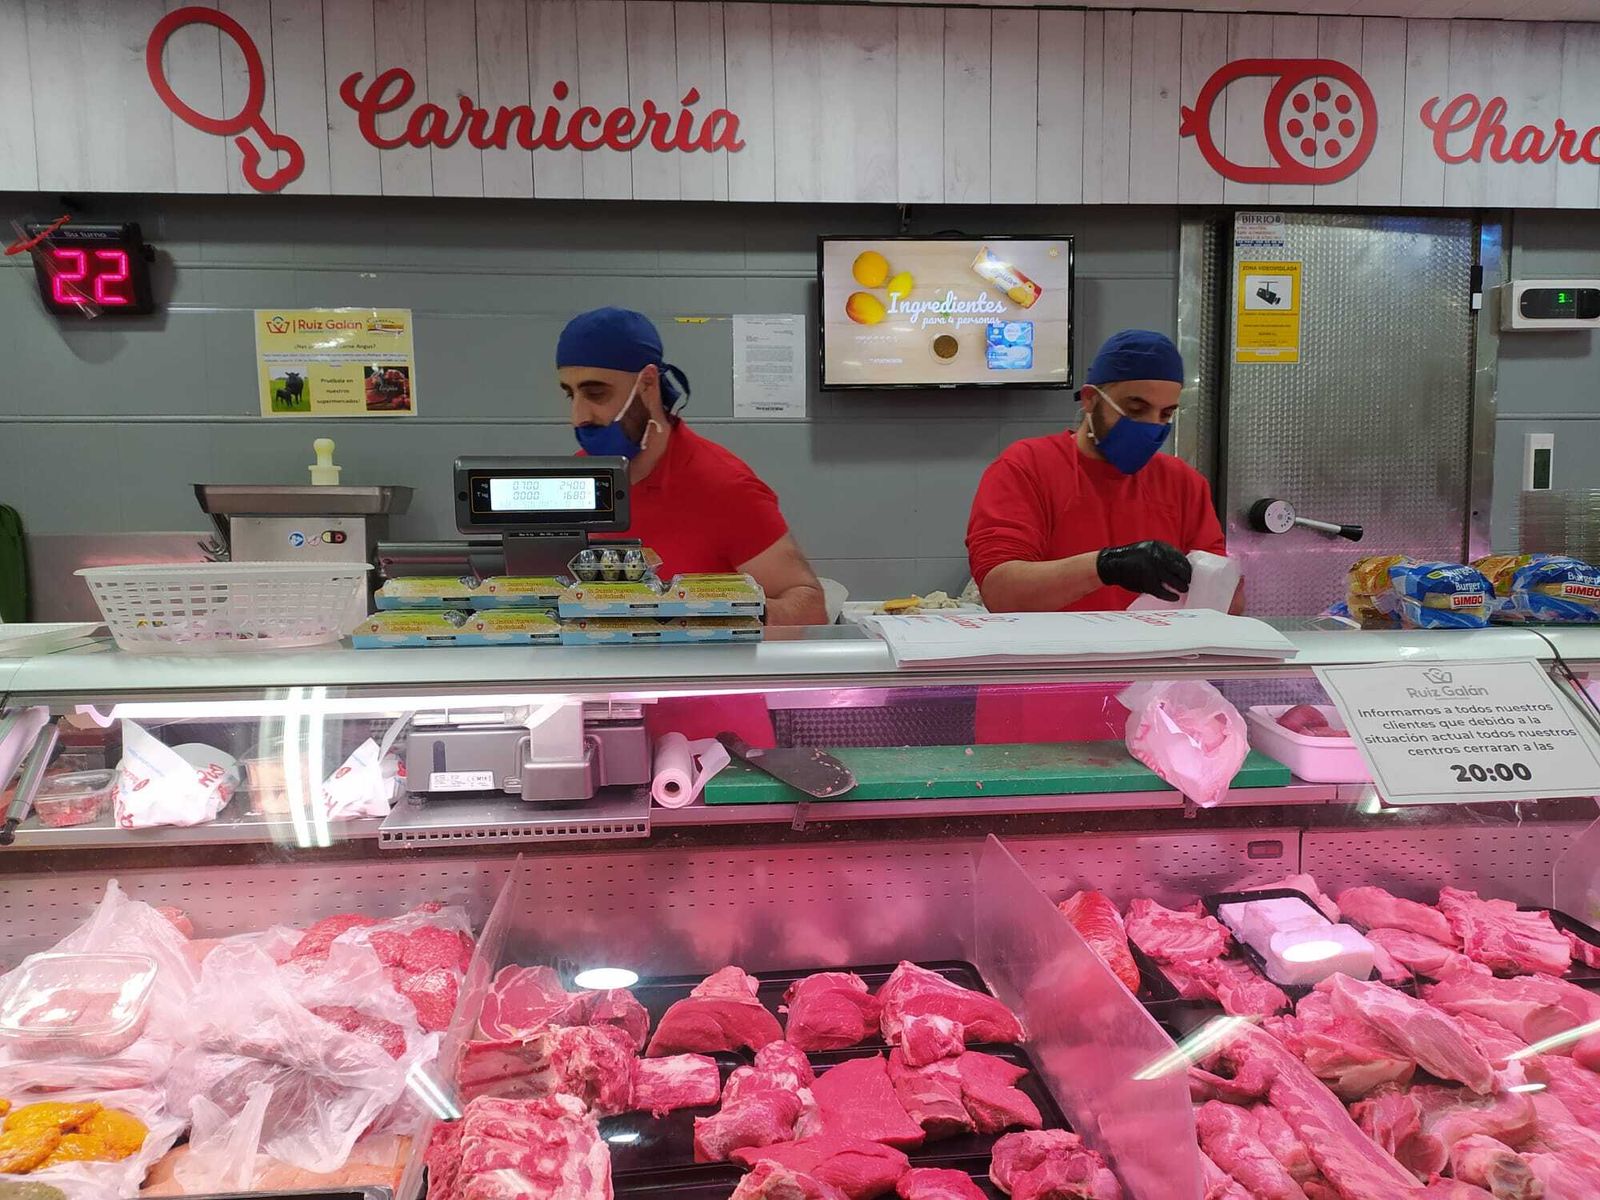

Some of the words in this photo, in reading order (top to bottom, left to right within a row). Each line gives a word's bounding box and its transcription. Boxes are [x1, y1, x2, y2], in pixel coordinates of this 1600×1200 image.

[340, 67, 746, 153] Carnicería
[53, 249, 128, 304] 22
[887, 290, 1007, 324] Ingredientes
[298, 319, 323, 330] Ruiz
[921, 316, 948, 330] para
[956, 315, 1001, 330] personas
[1454, 581, 1481, 592] Burger
[1564, 585, 1600, 598] BIMBO
[1453, 595, 1483, 606] BIMBO
[1406, 687, 1441, 699] Ruiz
[1441, 685, 1489, 697] Galán
[1358, 706, 1442, 718] Informamos
[1455, 703, 1493, 715] todos
[1495, 702, 1554, 713] nuestros
[1383, 719, 1436, 730] clientes
[1439, 719, 1466, 730] que
[1468, 716, 1515, 727] debido
[1517, 717, 1526, 725] a
[1527, 715, 1542, 725] la
[1364, 733, 1429, 745] situación
[1432, 730, 1475, 743] actual
[1476, 729, 1516, 740] todos
[1518, 728, 1578, 738] nuestros
[1408, 746, 1461, 757] centros
[1463, 742, 1520, 754] cerraran
[1523, 743, 1532, 752] a
[1533, 741, 1555, 751] las
[1450, 762, 1532, 783] 20:00
